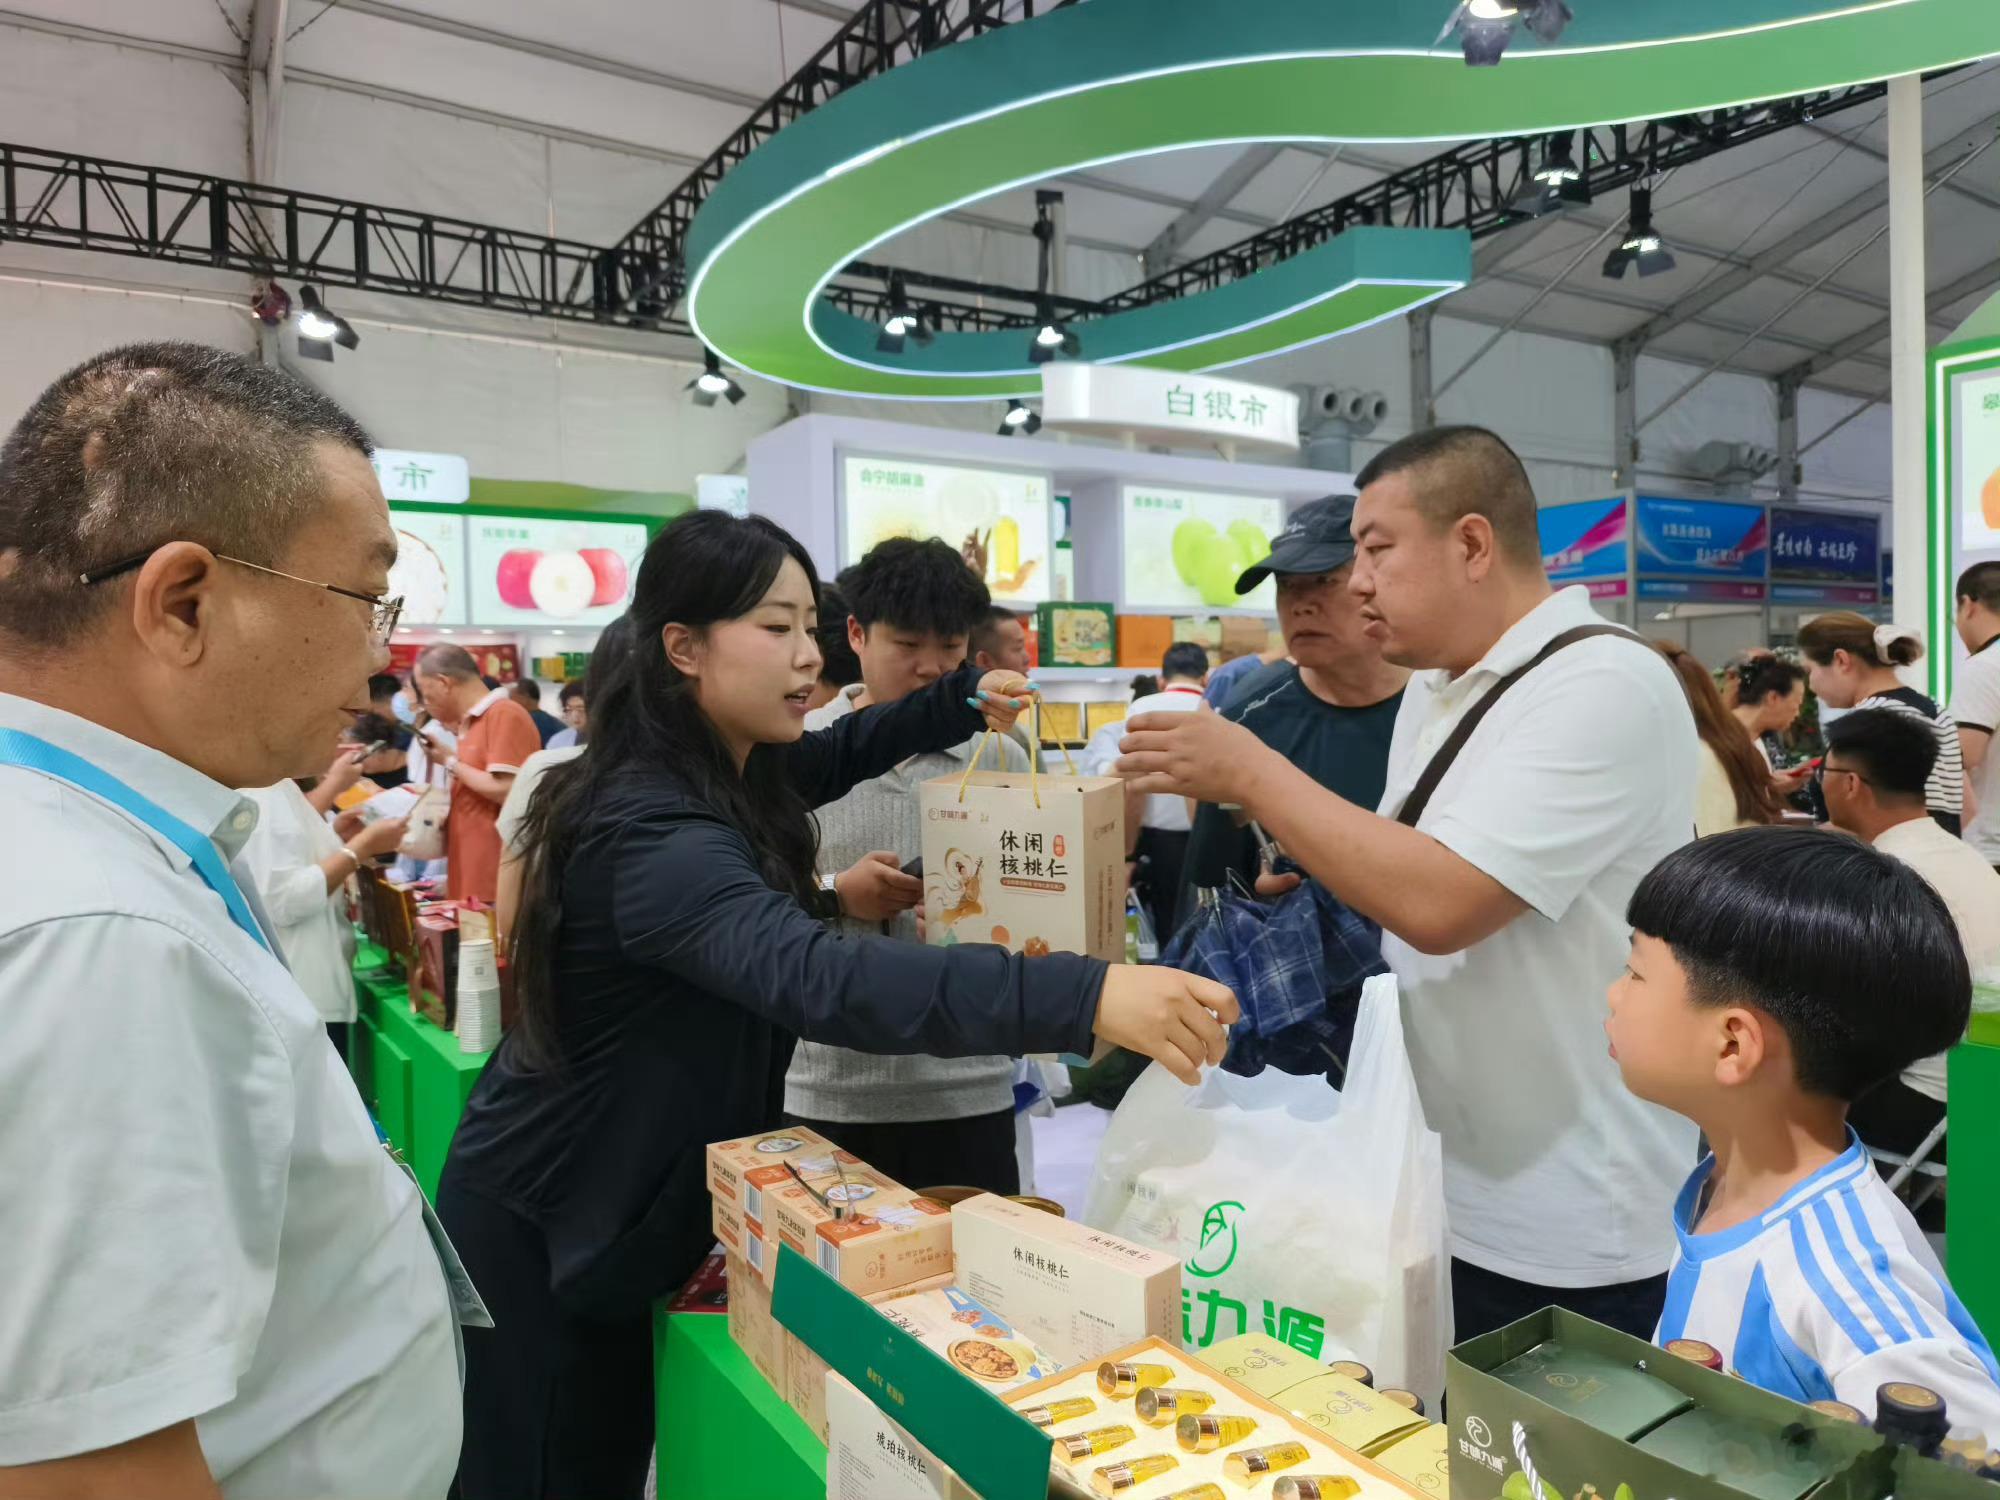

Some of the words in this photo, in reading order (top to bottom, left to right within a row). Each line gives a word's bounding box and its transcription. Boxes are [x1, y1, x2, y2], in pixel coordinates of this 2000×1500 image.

[1167, 384, 1268, 427] 白银市
[375, 461, 434, 491] 市
[999, 830, 1043, 854] 休闲
[999, 853, 1068, 878] 核桃仁
[1012, 1246, 1070, 1280] 休闲核桃仁
[1087, 1234, 1151, 1262] 休闲核桃仁
[876, 1431, 927, 1475] 琥珀核桃仁
